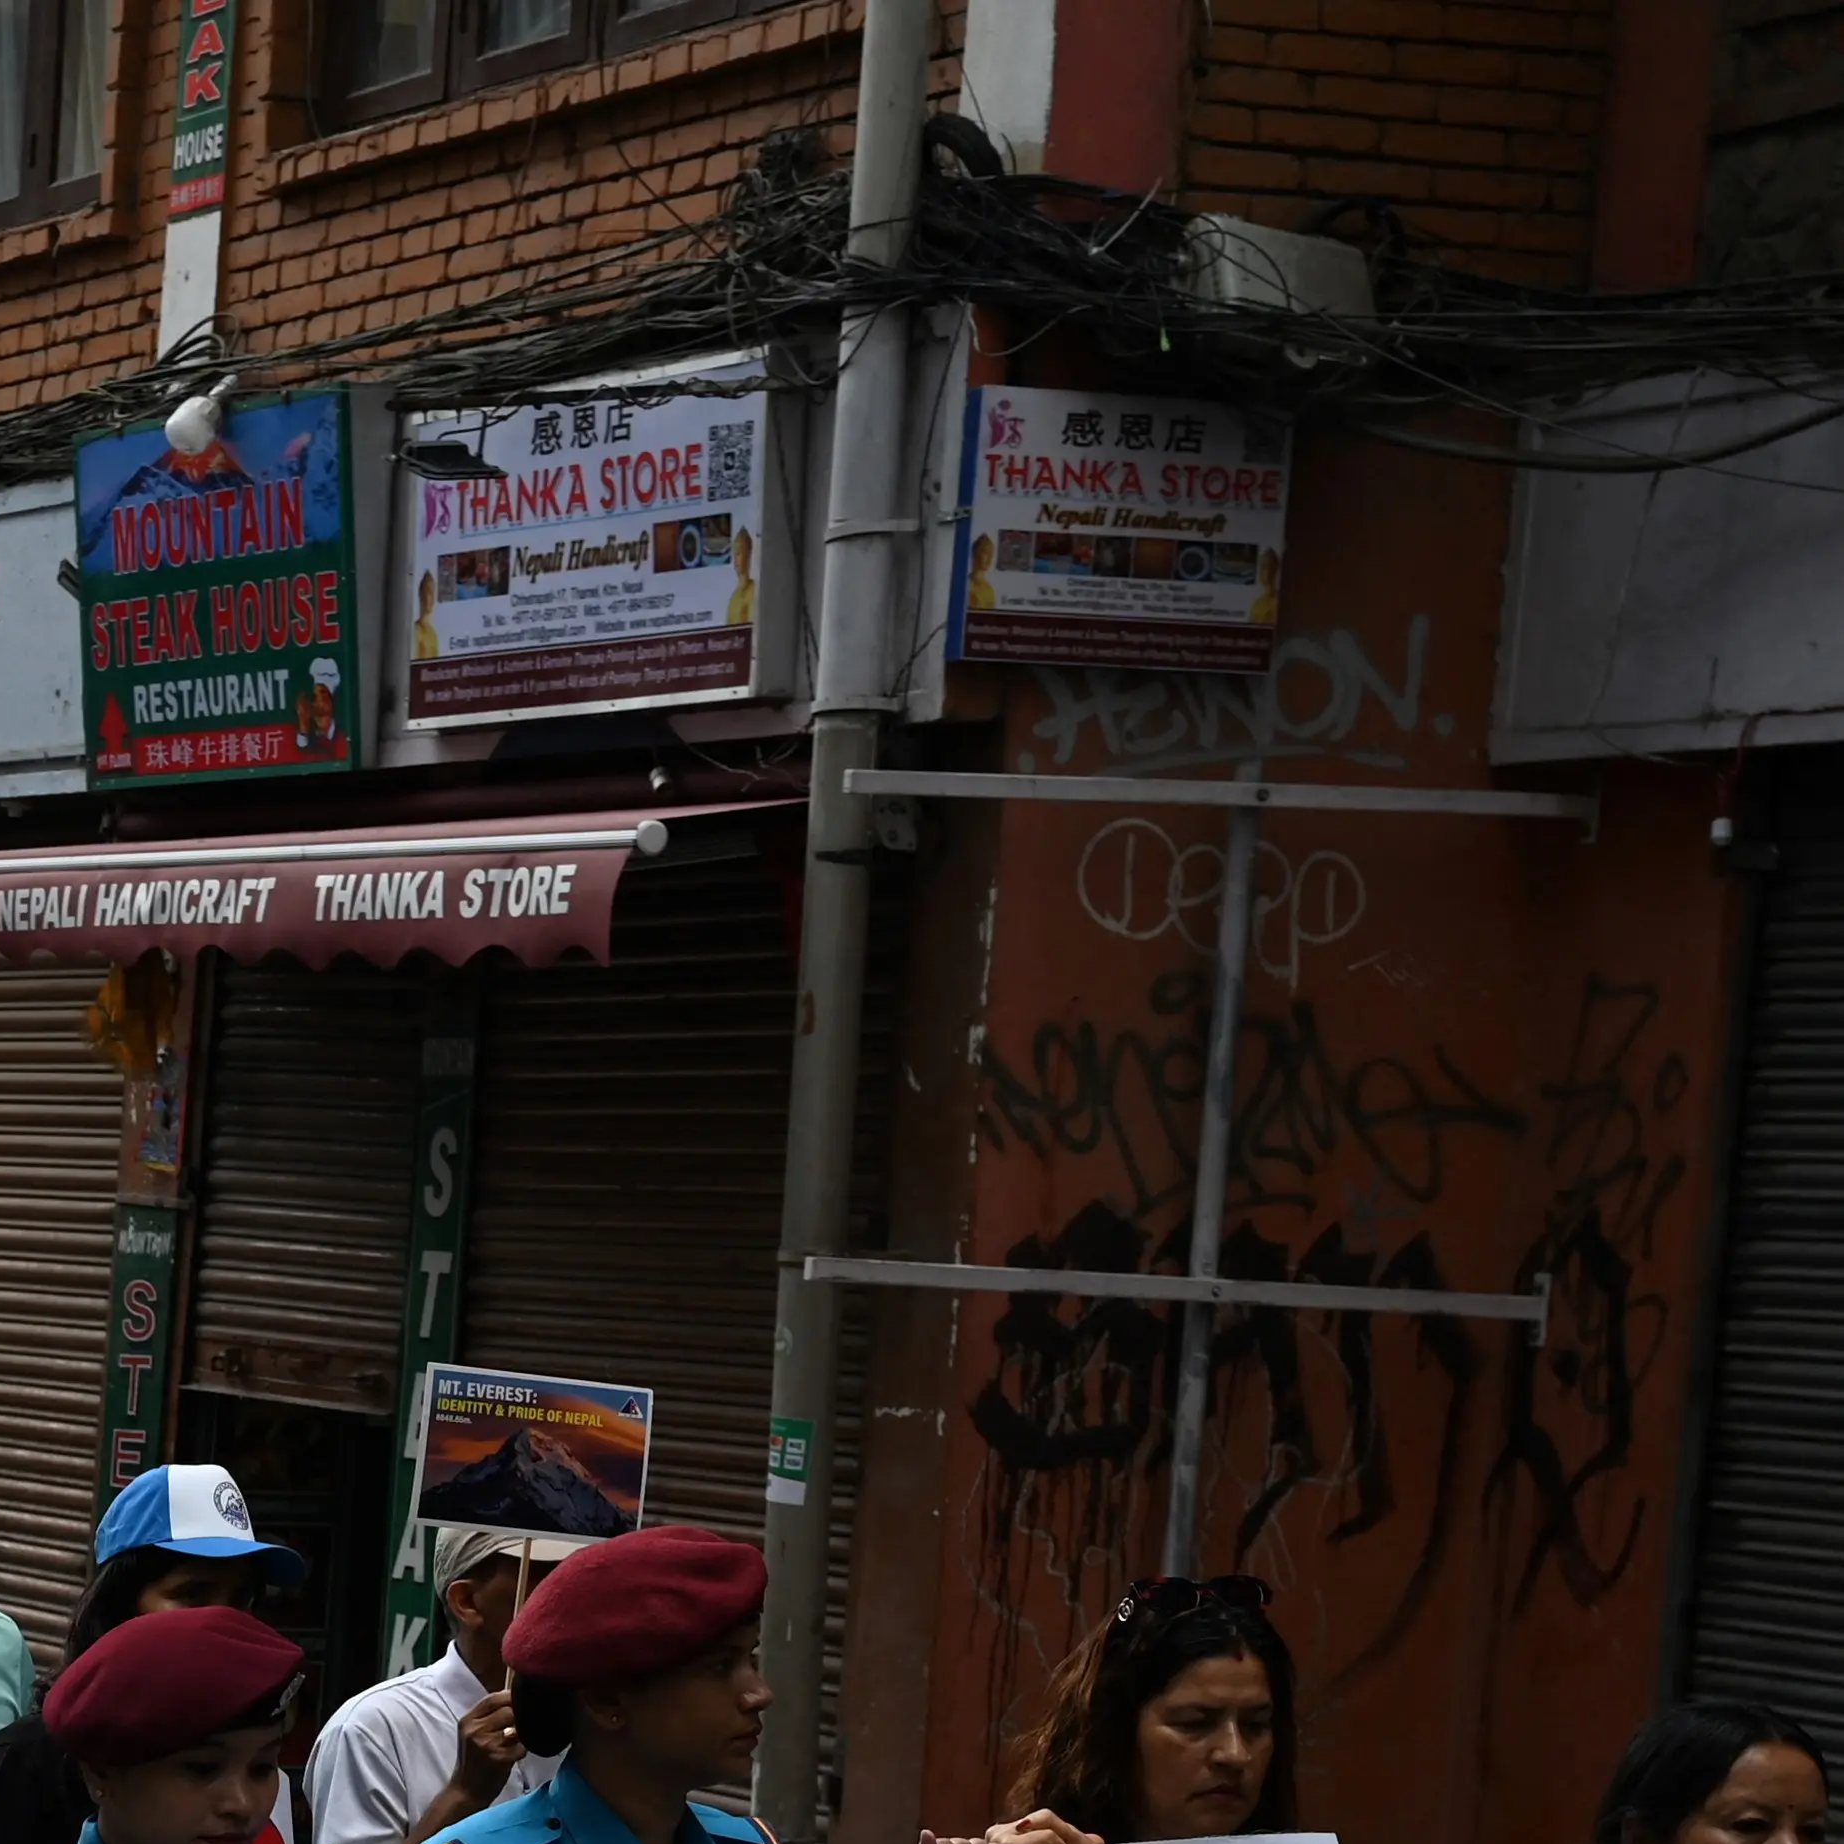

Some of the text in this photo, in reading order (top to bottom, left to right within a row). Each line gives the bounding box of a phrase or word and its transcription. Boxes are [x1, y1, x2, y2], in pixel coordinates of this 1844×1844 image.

[173, 123, 225, 171] HOUSE
[530, 399, 634, 456] 感恩店
[1062, 409, 1207, 455] 感恩店
[455, 443, 703, 530] THANKA STORE
[985, 454, 1282, 504] THANKA STORE
[112, 476, 306, 577] MOUNTAIN
[1035, 504, 1228, 538] Nepali Handicraft
[511, 530, 650, 578] Nepali Handicraft
[90, 570, 341, 672] STEAK HOUSE
[132, 668, 290, 725] RESTAURANT
[144, 730, 285, 769] 珠峰牛排餐厅
[93, 875, 277, 927] HANDICRAFT
[314, 870, 445, 923] THANKA
[458, 862, 578, 919] STORE
[437, 1398, 604, 1428] IDENTITY & PRIDE OF NEPAL
[438, 1378, 539, 1404] MT. EVEREST:
